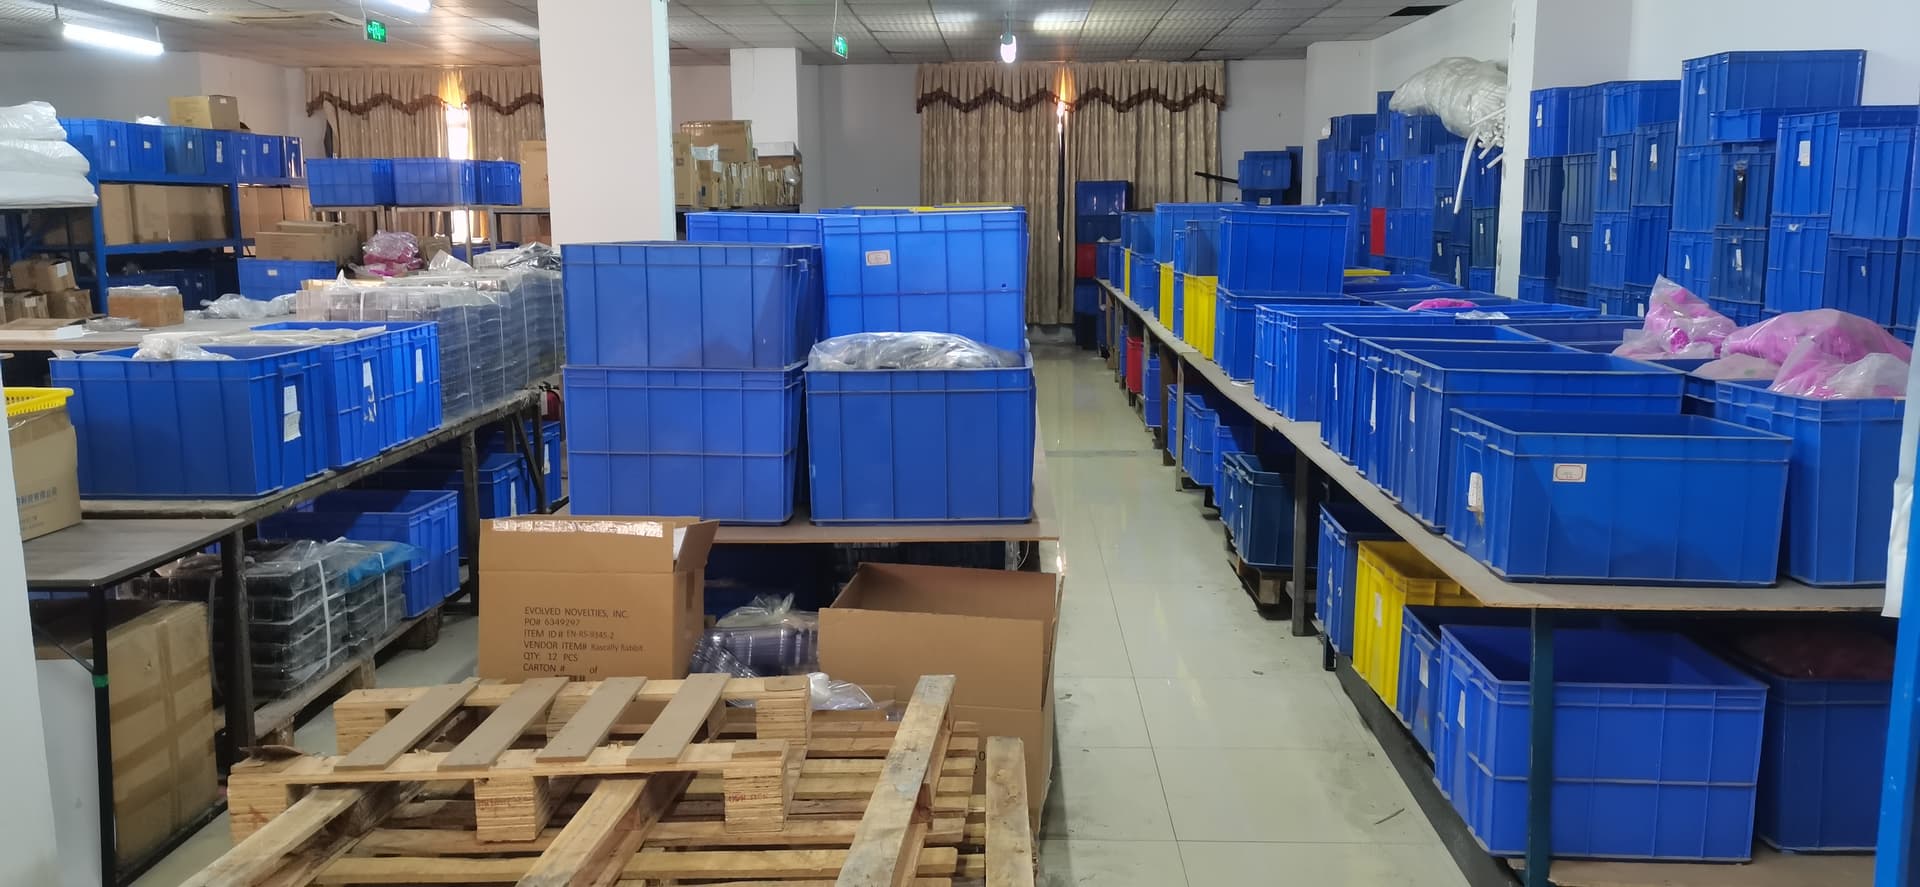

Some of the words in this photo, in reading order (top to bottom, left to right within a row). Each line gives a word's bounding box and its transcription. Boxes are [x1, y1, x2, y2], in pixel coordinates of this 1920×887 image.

[524, 606, 561, 616] EVOLVED
[564, 607, 609, 618] NOVELTIES,
[524, 617, 541, 626] PO#
[524, 629, 545, 638] ITEM
[523, 640, 558, 650] VENDOR
[561, 641, 587, 651] ITEM#
[548, 652, 558, 661] 12
[563, 652, 578, 662] PCS
[522, 662, 557, 672] CARTON
[589, 665, 598, 674] of
